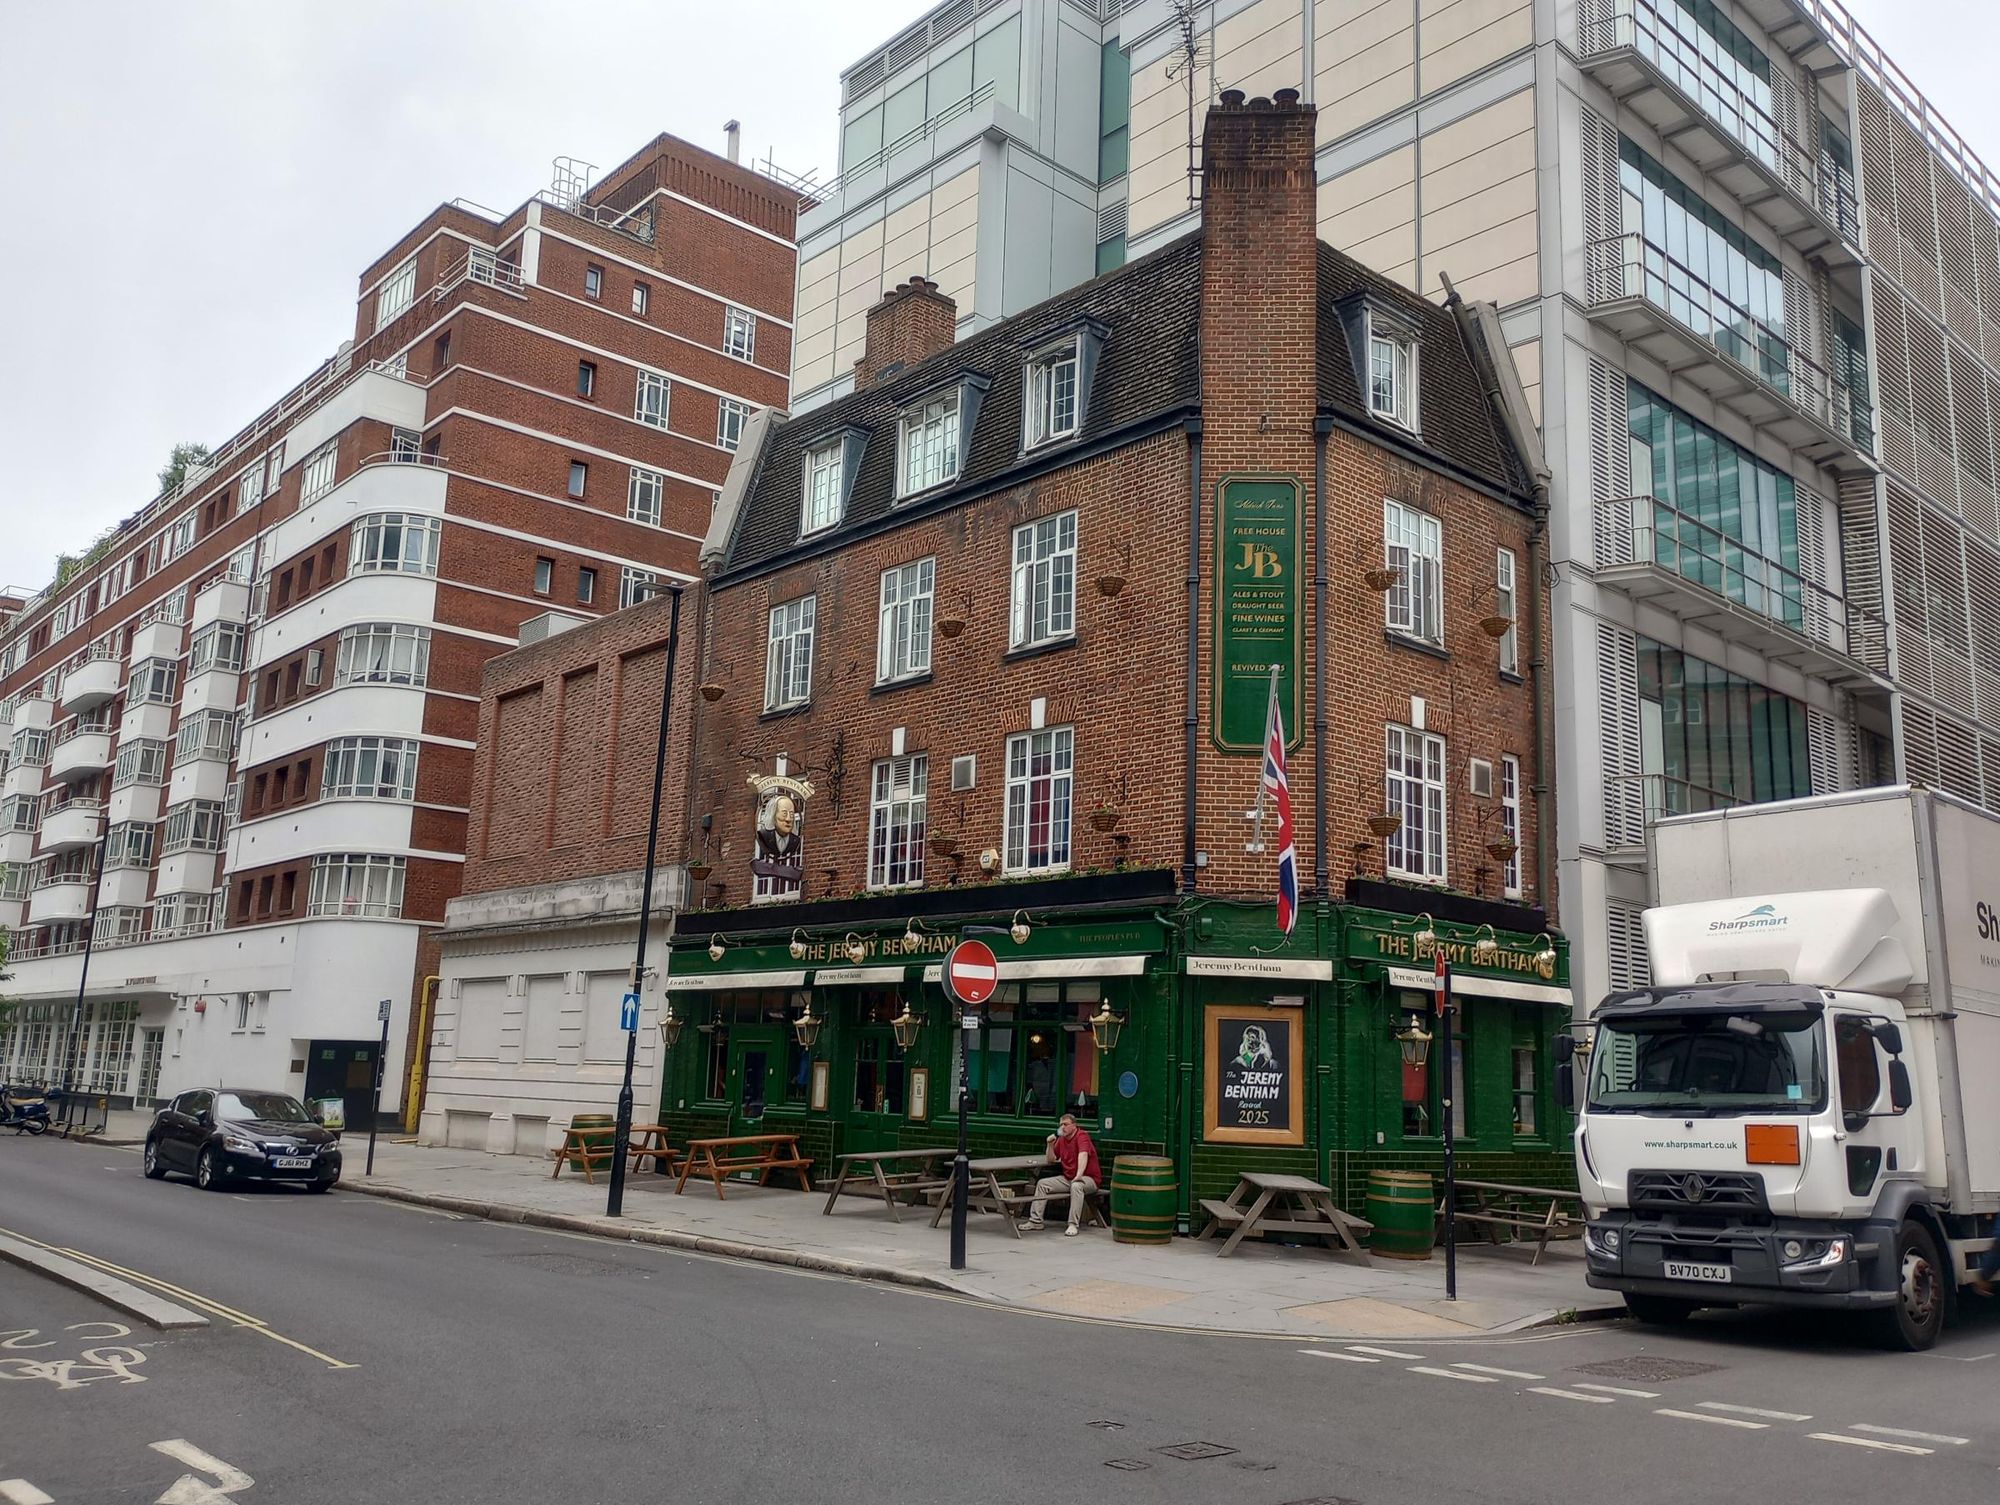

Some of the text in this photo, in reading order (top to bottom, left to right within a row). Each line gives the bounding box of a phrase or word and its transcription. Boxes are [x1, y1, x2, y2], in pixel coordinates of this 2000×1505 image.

[1233, 527, 1286, 536] FREE HOUSE
[1232, 614, 1286, 623] FINE WINES
[1232, 664, 1286, 672] REVIVED 25
[1708, 916, 1789, 931] Sharpsmart
[1376, 933, 1409, 956] THE
[801, 943, 826, 961] THE
[1193, 961, 1282, 973] Jeremy Bentham
[1240, 1071, 1283, 1085] JEREMY
[1225, 1085, 1280, 1099] BENTHAM
[1238, 1110, 1270, 1124] 2025
[1644, 1140, 1738, 1150] www.sharpsmart.co.uk
[1669, 1264, 1727, 1280] BV70 CXJ
